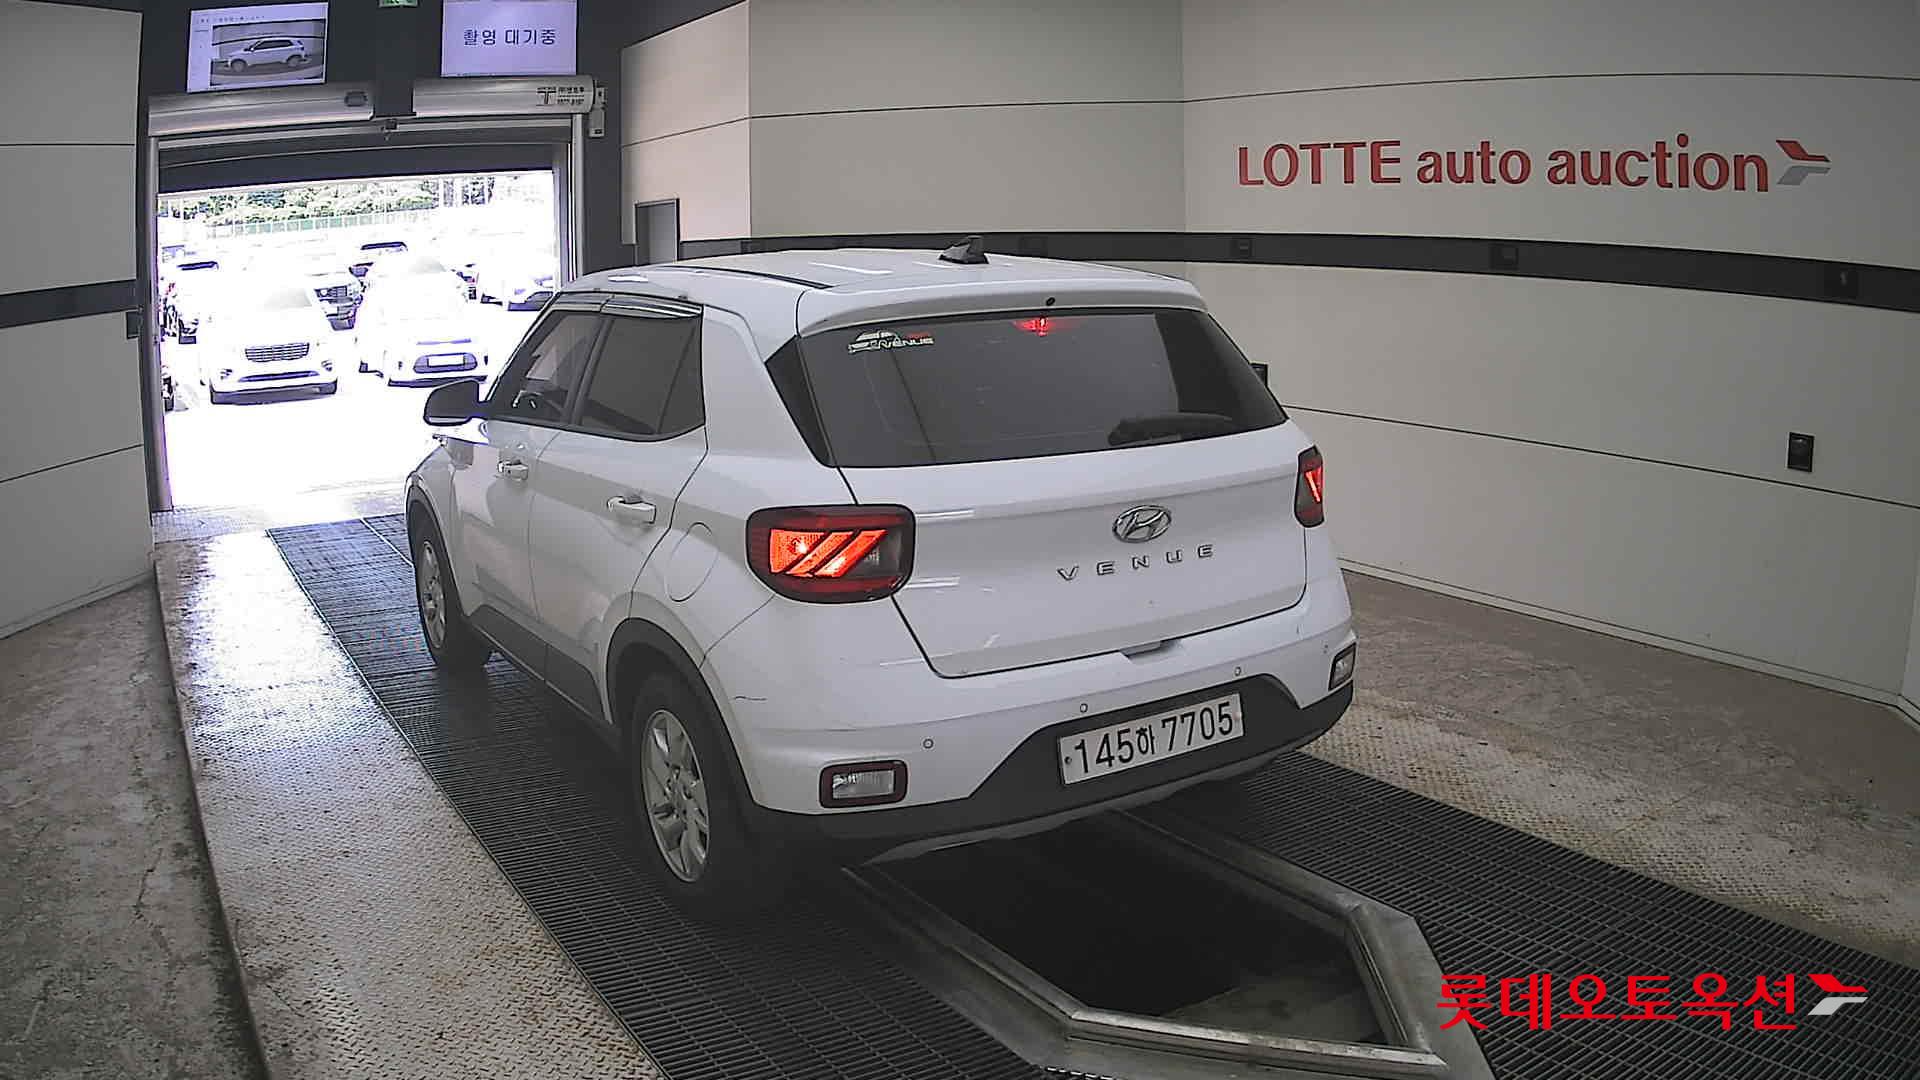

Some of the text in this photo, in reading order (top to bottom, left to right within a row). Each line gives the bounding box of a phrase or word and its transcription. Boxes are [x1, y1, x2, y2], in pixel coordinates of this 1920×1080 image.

[504, 28, 557, 46] 대기중
[1238, 133, 1769, 191] LOTTE auto auction
[1057, 544, 1214, 582] VENUE
[1074, 701, 1234, 774] 145하 7705
